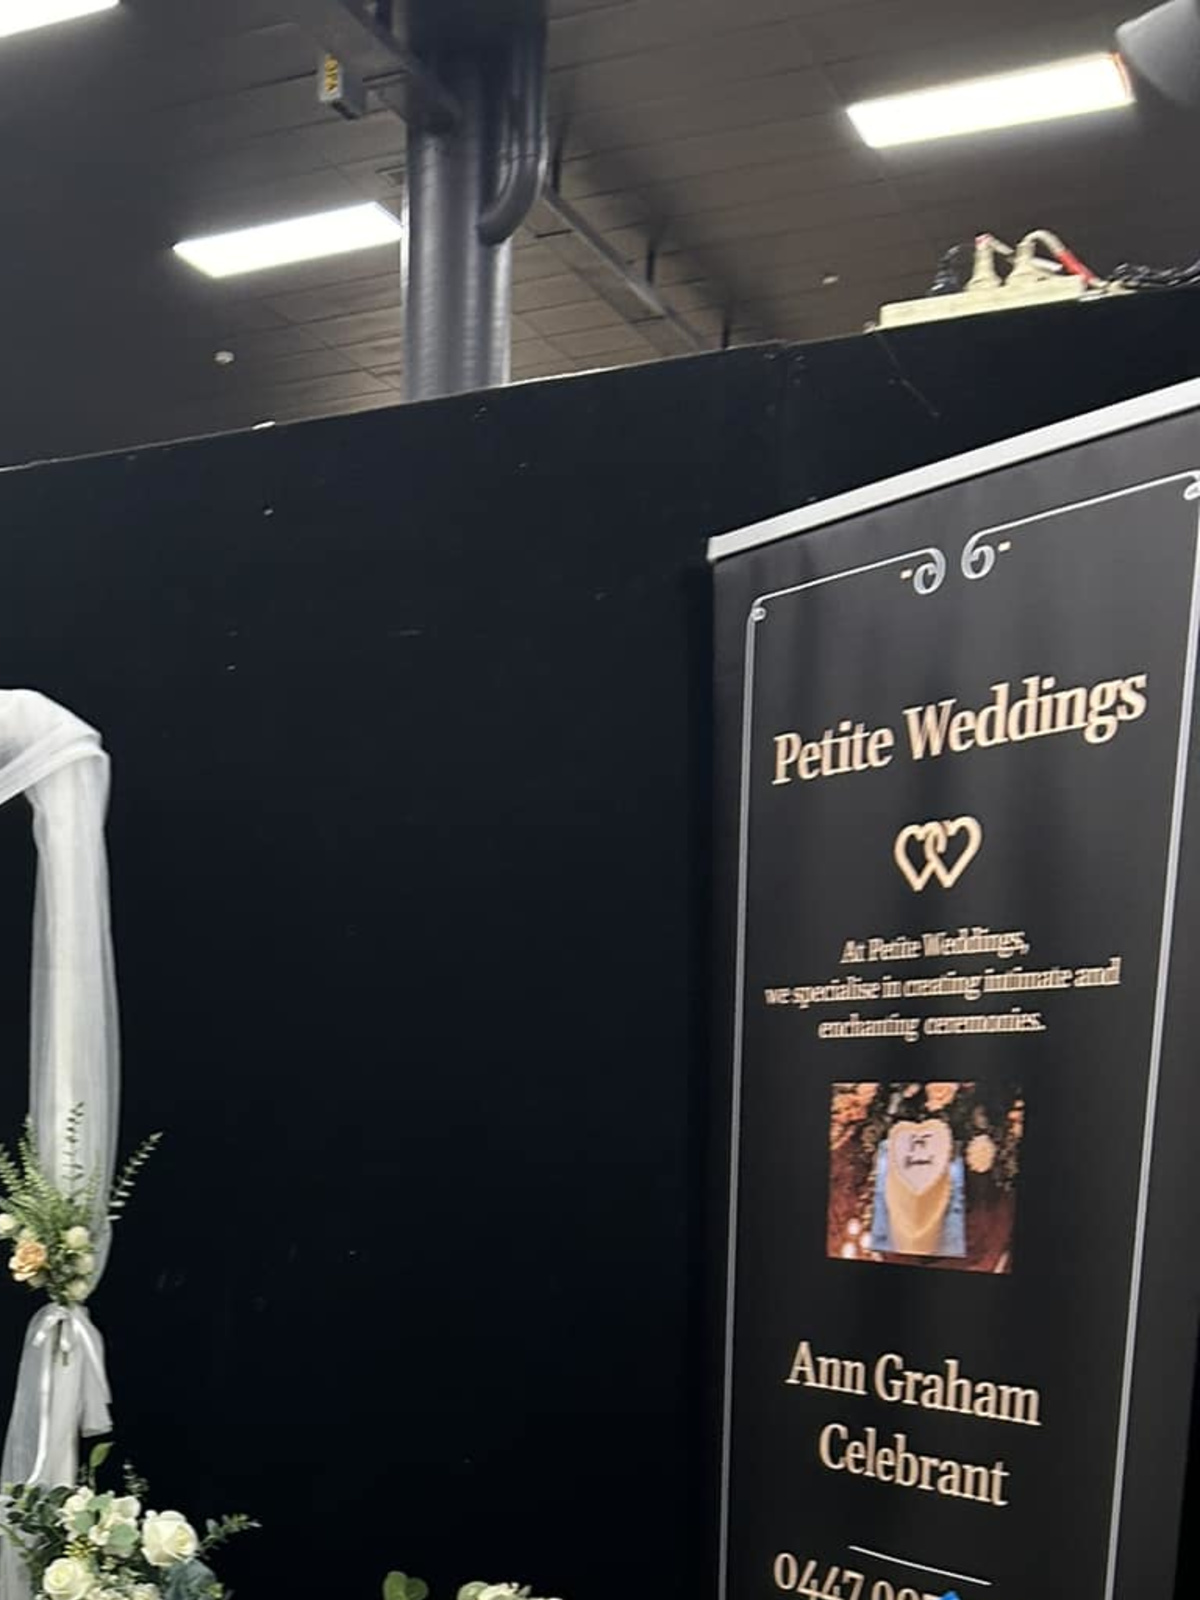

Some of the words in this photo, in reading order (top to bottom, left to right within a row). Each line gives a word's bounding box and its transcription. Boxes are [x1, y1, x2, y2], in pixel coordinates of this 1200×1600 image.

[771, 719, 893, 785] Petite
[903, 672, 1149, 759] Weddings
[764, 987, 790, 1004] we
[790, 976, 881, 1009] specialise
[882, 975, 902, 998] in
[902, 971, 983, 1000] creating
[983, 966, 1073, 992] intimate
[1073, 955, 1122, 987] and
[839, 940, 866, 964] At
[868, 936, 922, 961] Petite
[817, 1013, 921, 1042] enchanting
[785, 1339, 866, 1396] Ann
[874, 1354, 1043, 1427] Graham
[819, 1422, 1009, 1506] Celebrant
